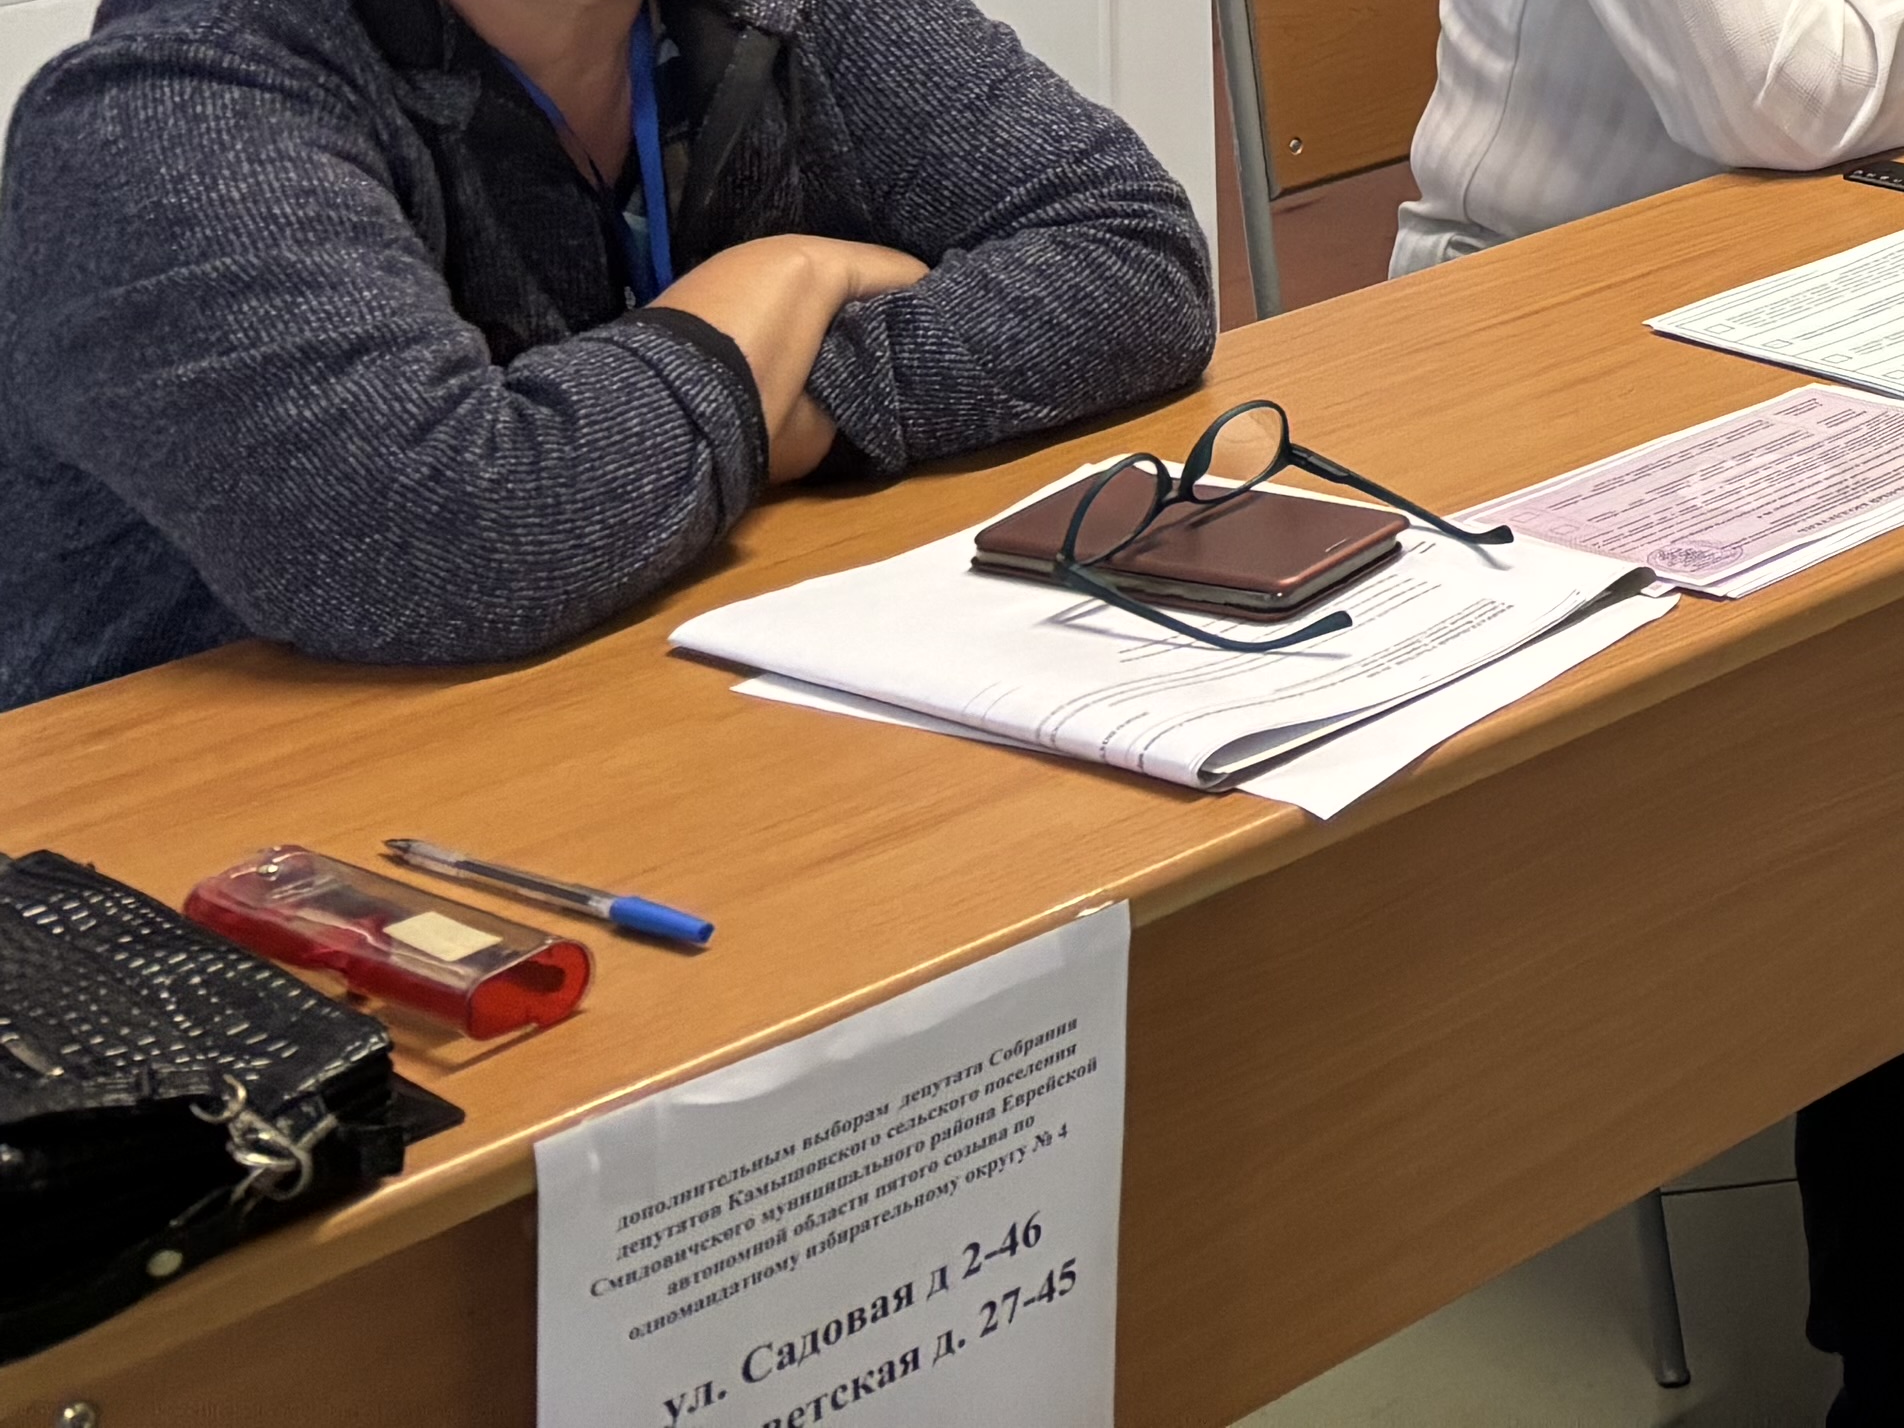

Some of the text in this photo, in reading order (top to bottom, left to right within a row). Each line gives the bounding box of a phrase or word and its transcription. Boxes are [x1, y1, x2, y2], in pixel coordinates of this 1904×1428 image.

[589, 1055, 1098, 1298] Смидовичского муниципального района Еврейской
[614, 1043, 1078, 1260] депутатов Камышовского сельского поселения
[616, 1017, 1079, 1232] дополнительным выборам депутата Собрания
[628, 1122, 1069, 1340] одномандатному избирательному округу № 4
[666, 1115, 1036, 1296] автономной области пятого созыва по
[662, 1209, 1044, 1428] ул. Садовая д 2-46
[761, 1259, 1077, 1428] етская д. 27-45
